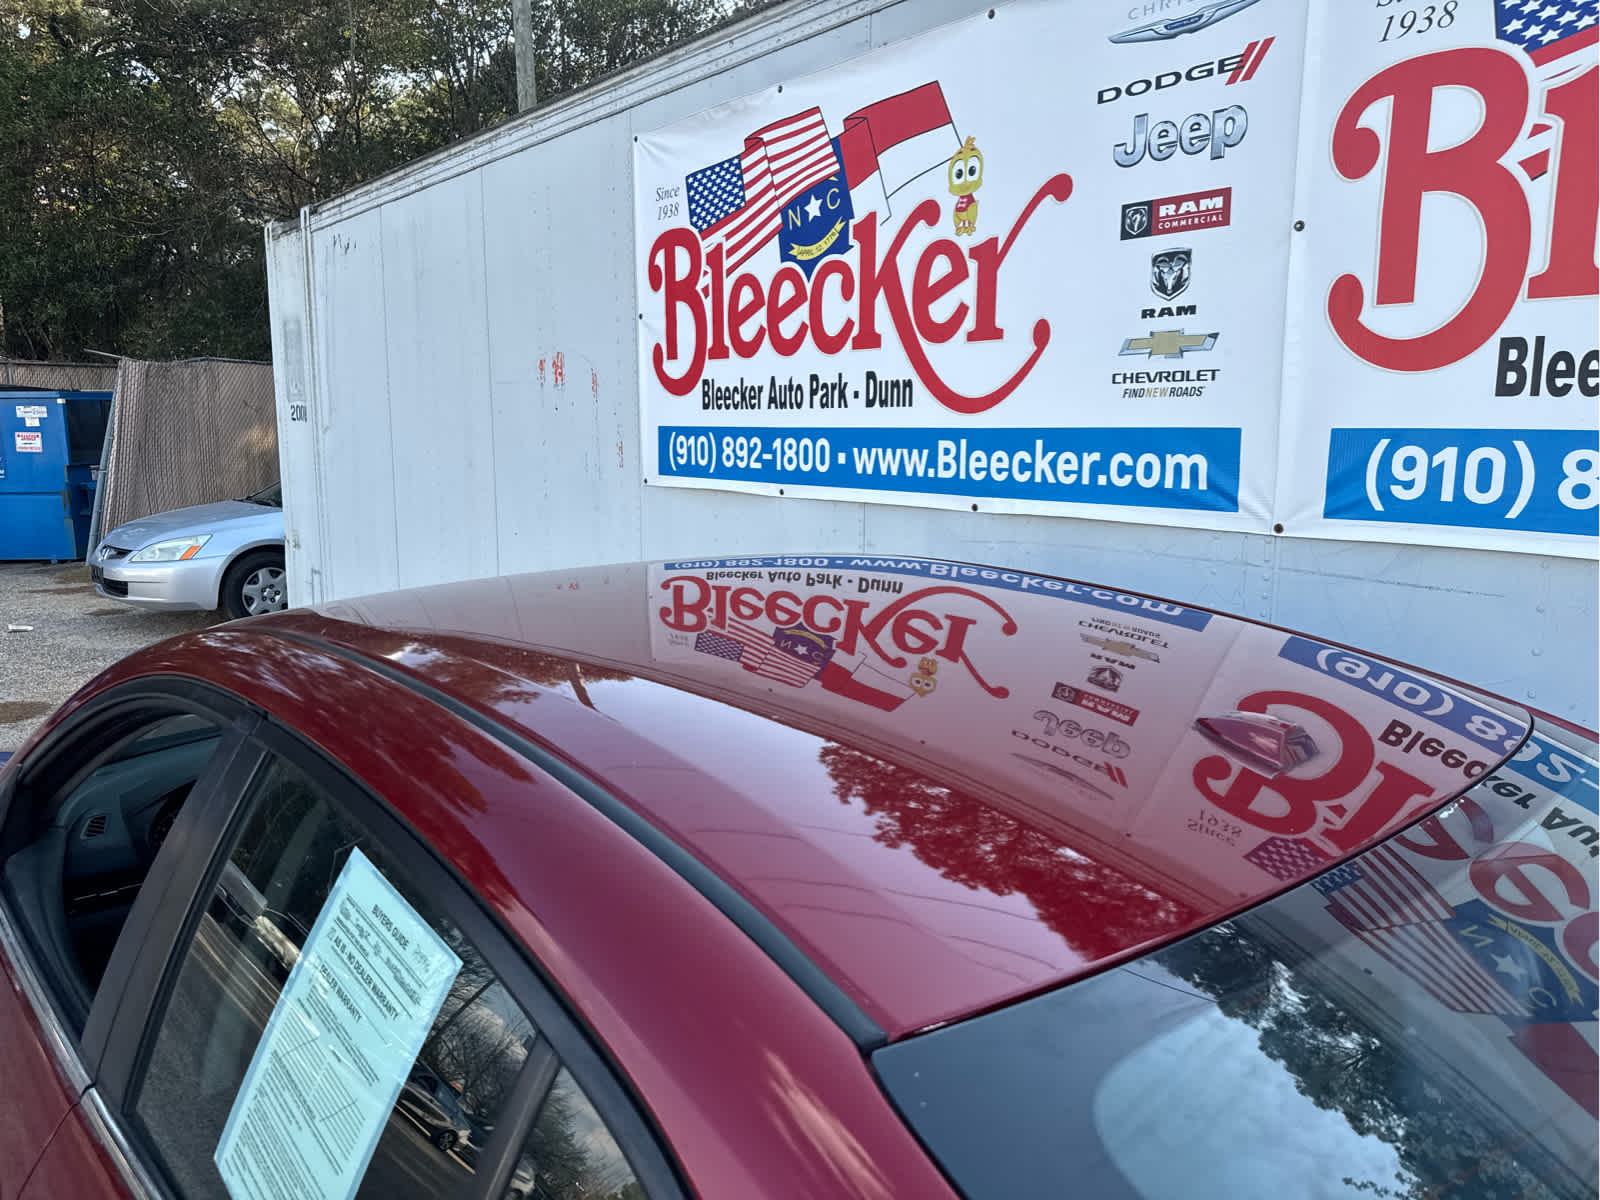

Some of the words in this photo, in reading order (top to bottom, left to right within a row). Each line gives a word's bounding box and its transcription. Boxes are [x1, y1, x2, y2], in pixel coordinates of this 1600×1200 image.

[1377, 0, 1458, 43] 1938
[1097, 53, 1245, 105] DODGE
[1113, 104, 1248, 168] Jeep
[656, 185, 681, 201] Since
[657, 202, 680, 221] 1938
[1159, 196, 1224, 217] RAM
[1158, 213, 1224, 230] COMMERCIAL
[647, 173, 1073, 415] Bleecker
[1141, 304, 1198, 320] RAM
[702, 377, 764, 411] Bleecker
[767, 375, 804, 410] Auto
[809, 373, 849, 409] Park
[864, 370, 914, 409] Dunn
[1111, 368, 1221, 385] CHEVROLET
[669, 431, 717, 473] (910)
[721, 436, 831, 473] 892-1800
[853, 438, 1208, 491] www.Bleecker.com
[1365, 438, 1536, 520] (910)
[371, 903, 394, 933] BUYERS
[391, 927, 409, 952] GUIDE
